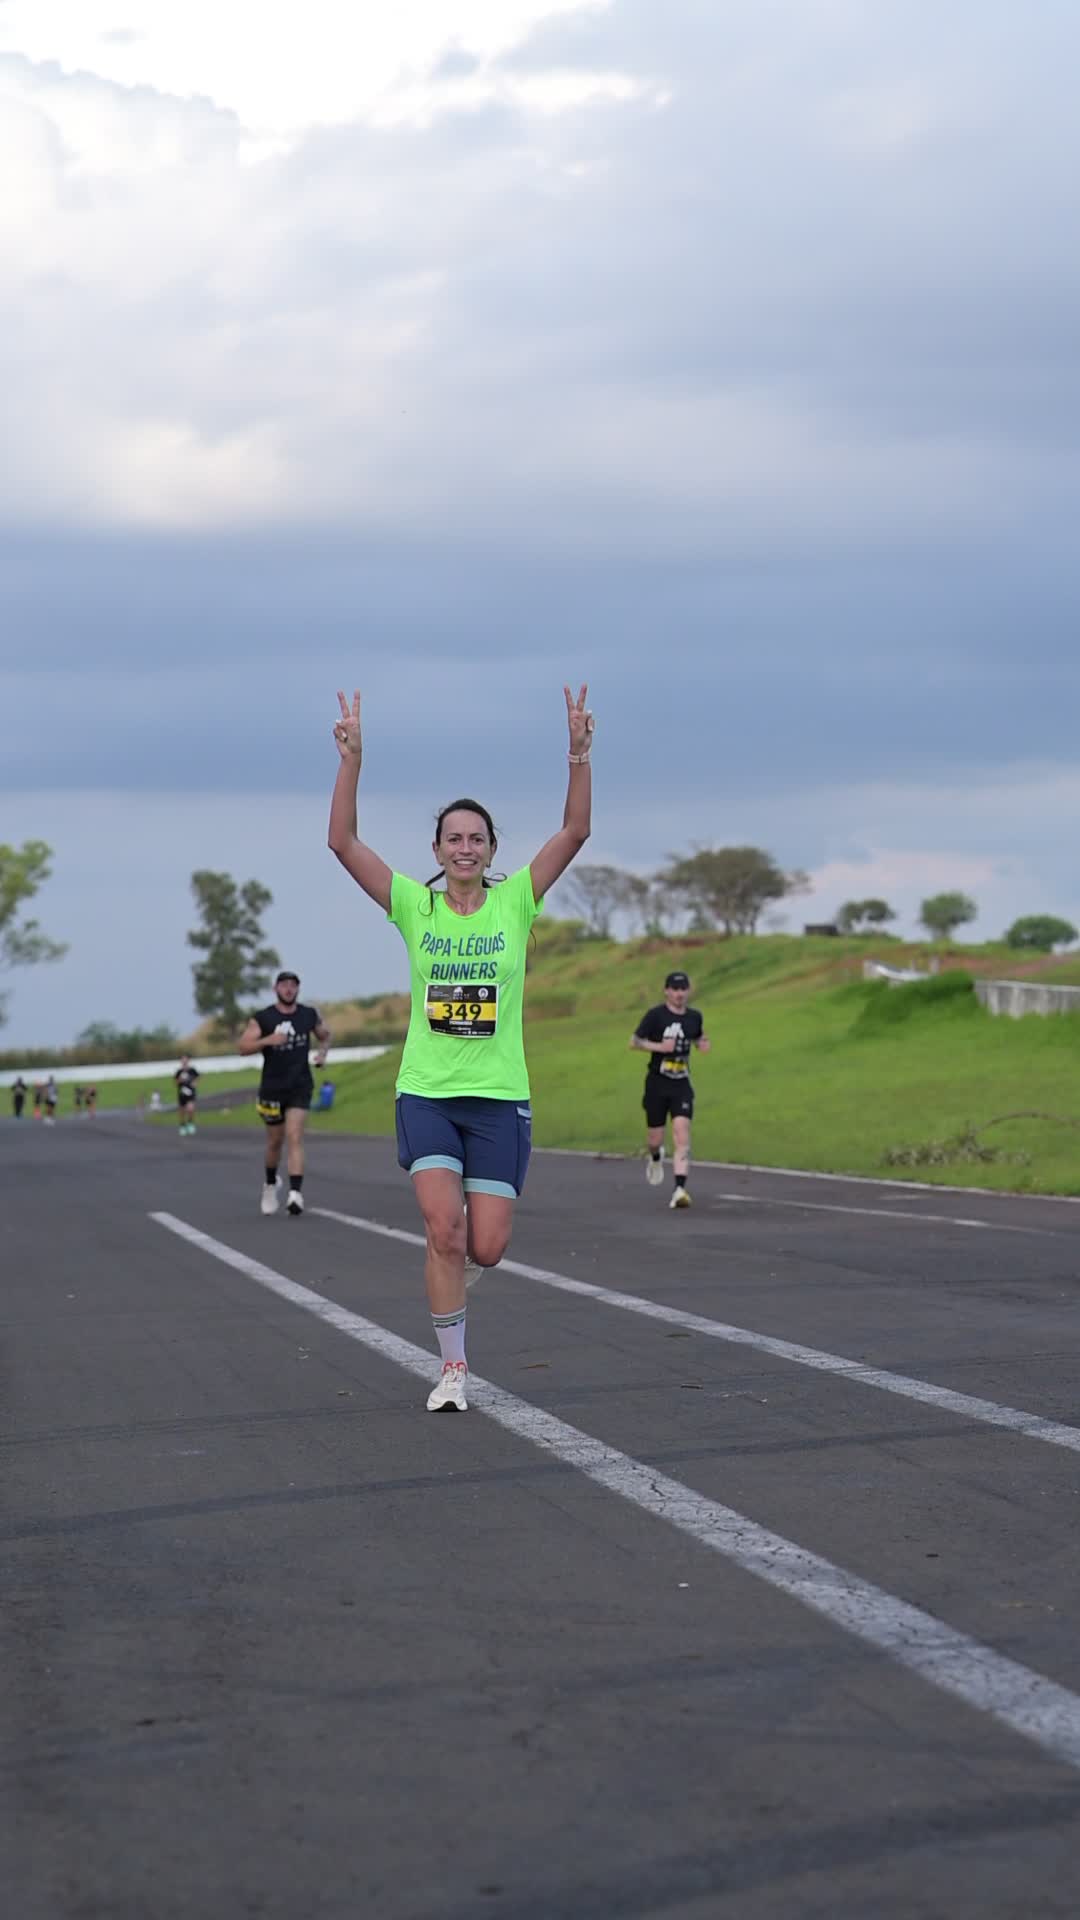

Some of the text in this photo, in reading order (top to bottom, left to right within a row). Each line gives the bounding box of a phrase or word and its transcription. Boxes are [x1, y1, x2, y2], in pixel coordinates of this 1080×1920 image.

[420, 931, 505, 956] PAPA-LÉGUAS
[430, 962, 498, 980] RUNNERS
[442, 1003, 482, 1021] 349
